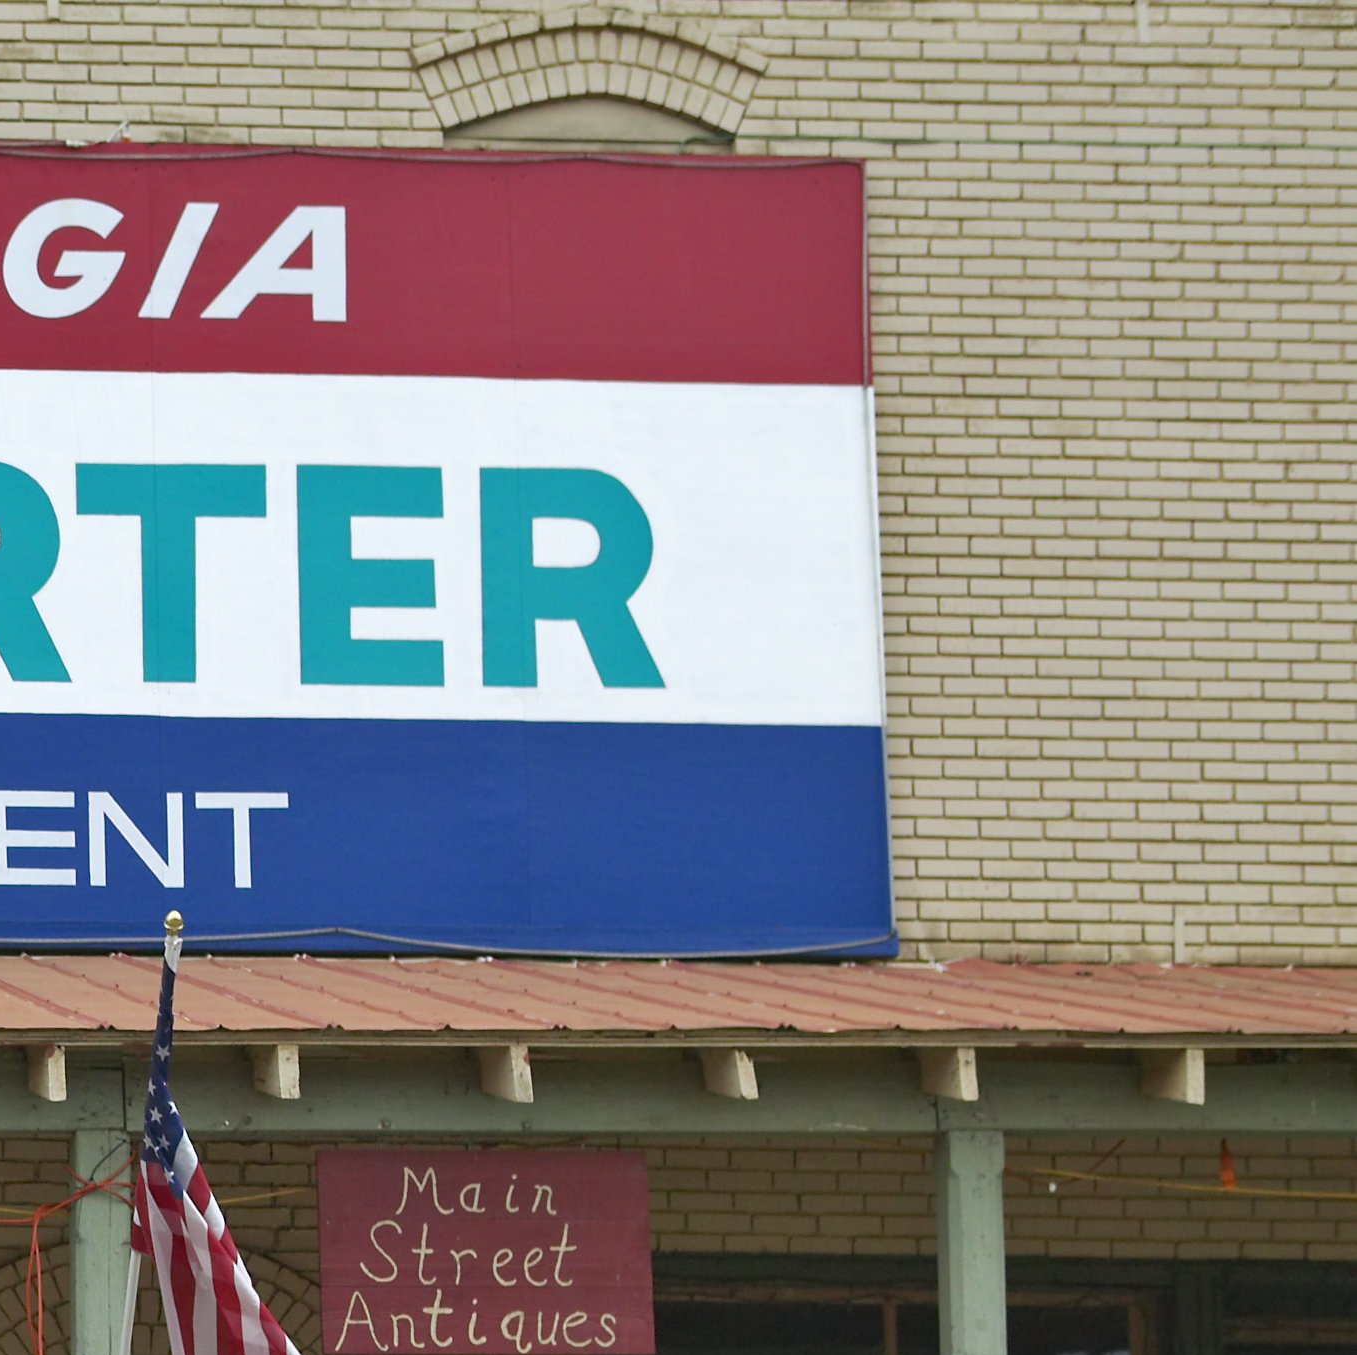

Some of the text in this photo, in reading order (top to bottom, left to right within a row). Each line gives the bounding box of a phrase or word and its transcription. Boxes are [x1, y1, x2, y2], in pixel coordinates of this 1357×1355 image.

[395, 1167, 557, 1215] Main
[360, 1220, 577, 1286] Street
[336, 1289, 616, 1354] Antiques
